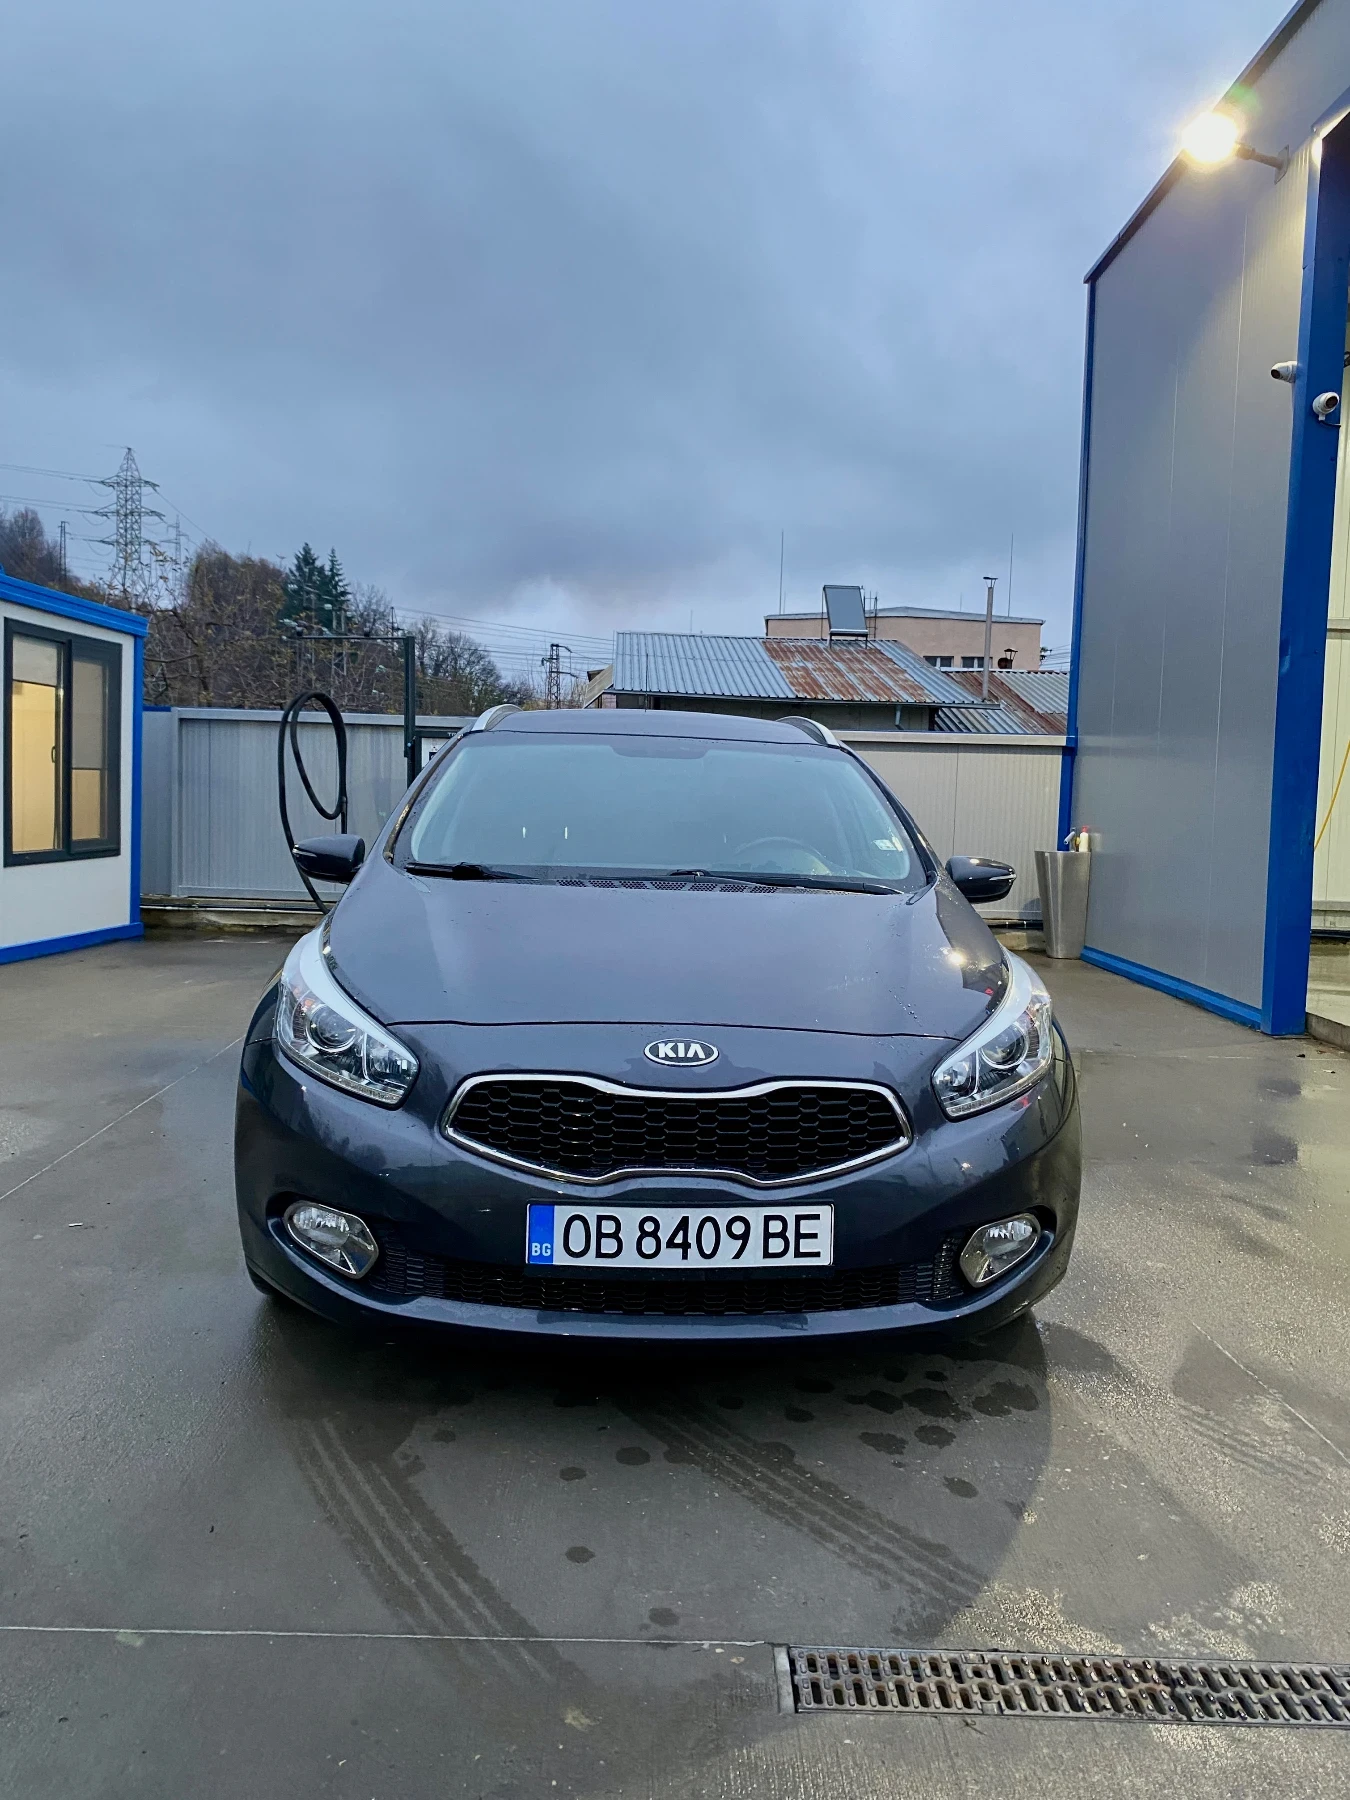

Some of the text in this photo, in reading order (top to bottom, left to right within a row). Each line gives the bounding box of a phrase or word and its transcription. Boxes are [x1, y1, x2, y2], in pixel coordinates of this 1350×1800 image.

[658, 1042, 706, 1059] KIA
[562, 1213, 822, 1261] OB 8409 BE
[530, 1242, 552, 1257] BG
